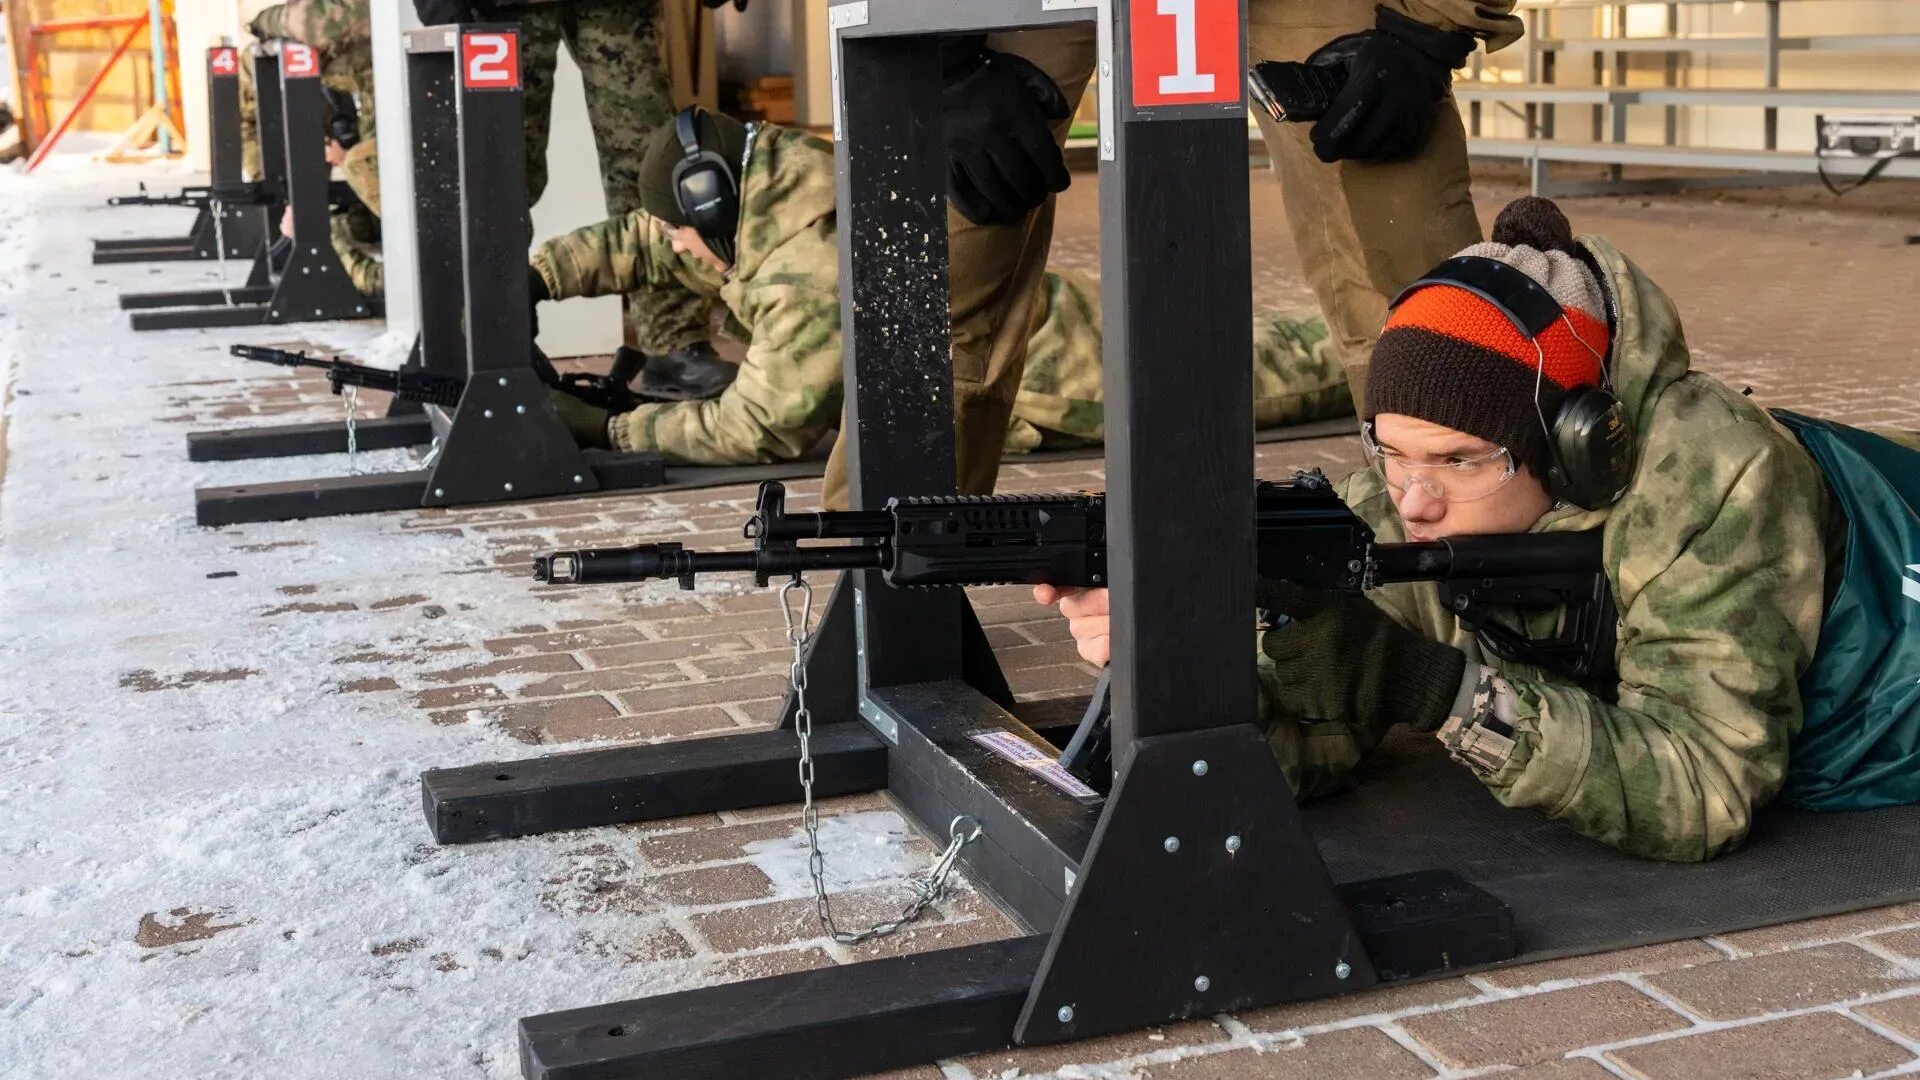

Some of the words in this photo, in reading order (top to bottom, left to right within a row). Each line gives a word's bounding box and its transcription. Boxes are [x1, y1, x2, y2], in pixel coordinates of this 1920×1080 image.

[213, 49, 235, 71] 4
[287, 43, 312, 72] 3
[470, 35, 508, 81] 2
[1157, 0, 1215, 94] 1
